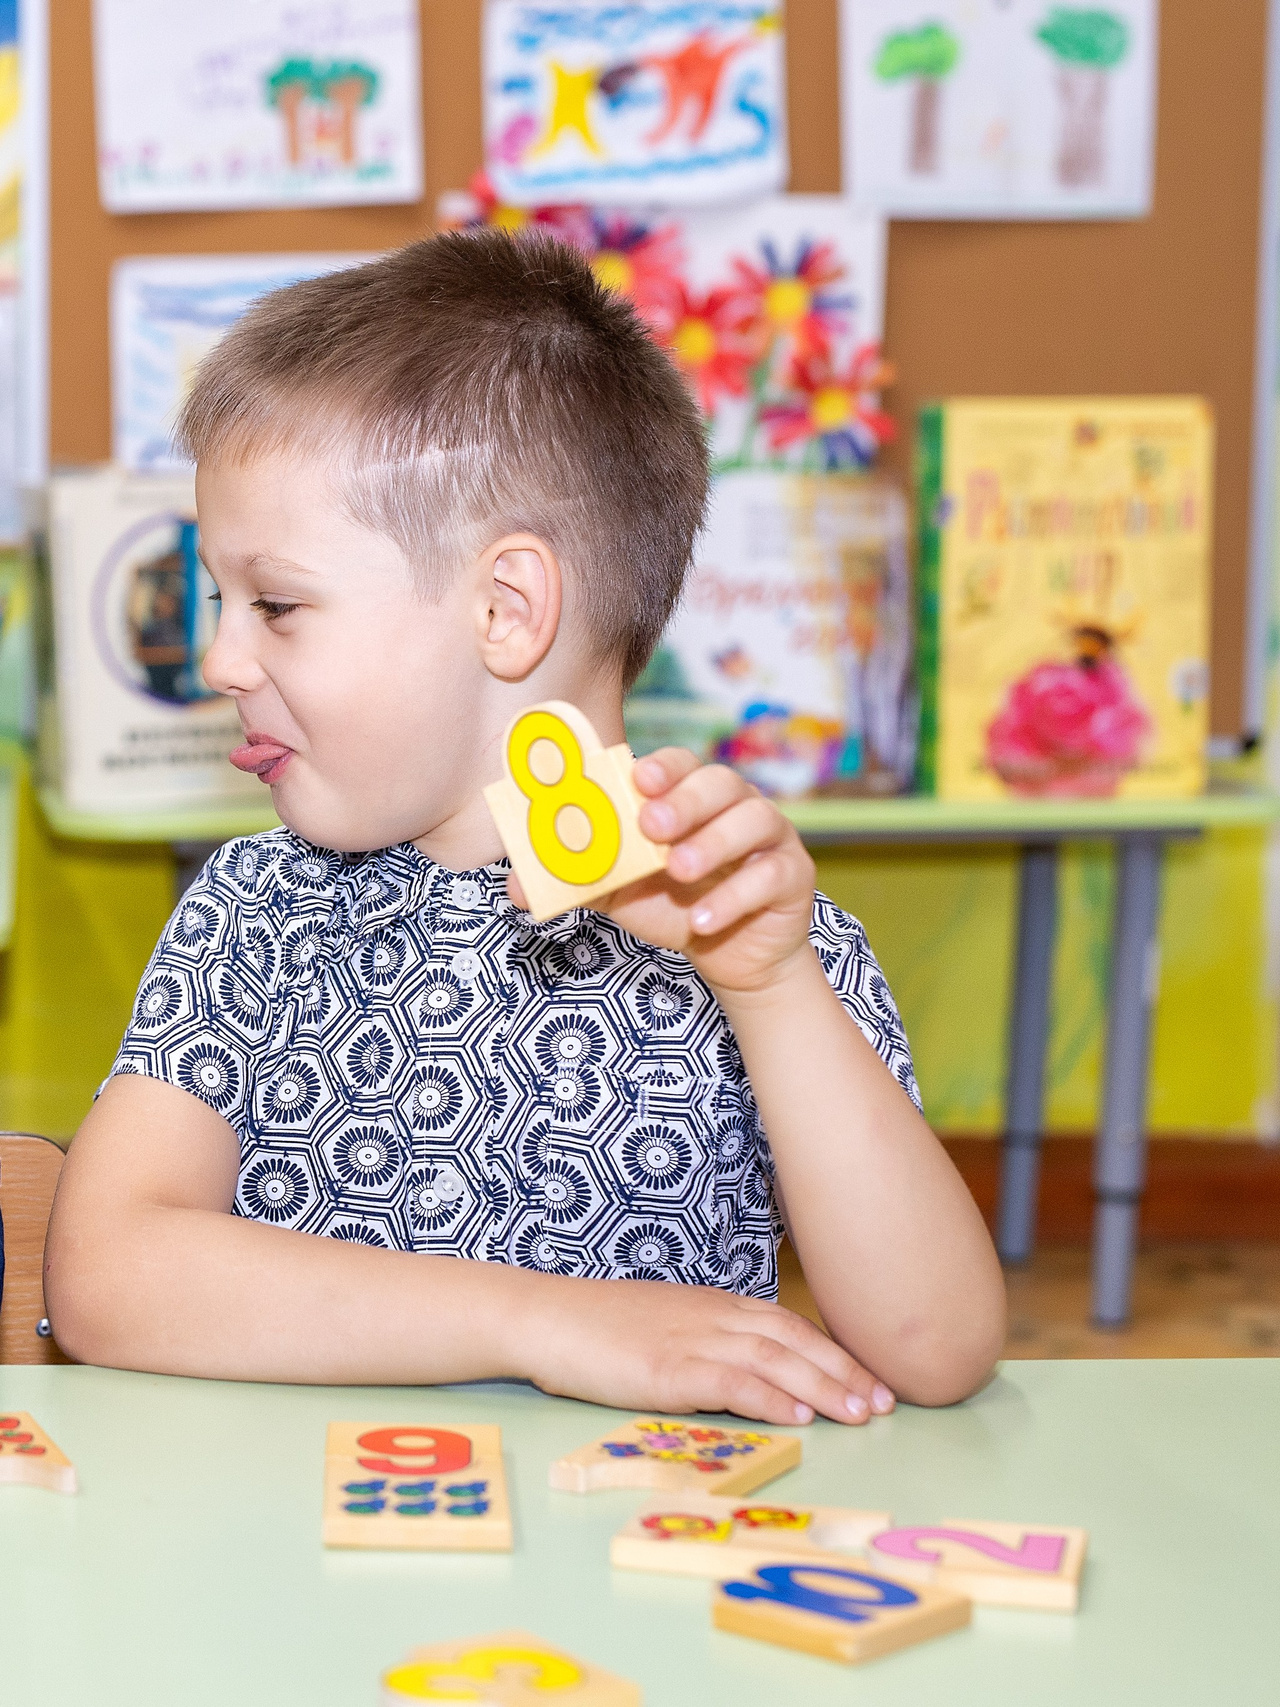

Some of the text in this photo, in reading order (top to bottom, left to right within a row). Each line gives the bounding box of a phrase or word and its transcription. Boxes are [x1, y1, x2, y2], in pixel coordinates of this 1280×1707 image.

[507, 711, 622, 886] 8
[356, 1427, 472, 1476] 9
[871, 1527, 1067, 1573] 2
[383, 1646, 583, 1701] 3
